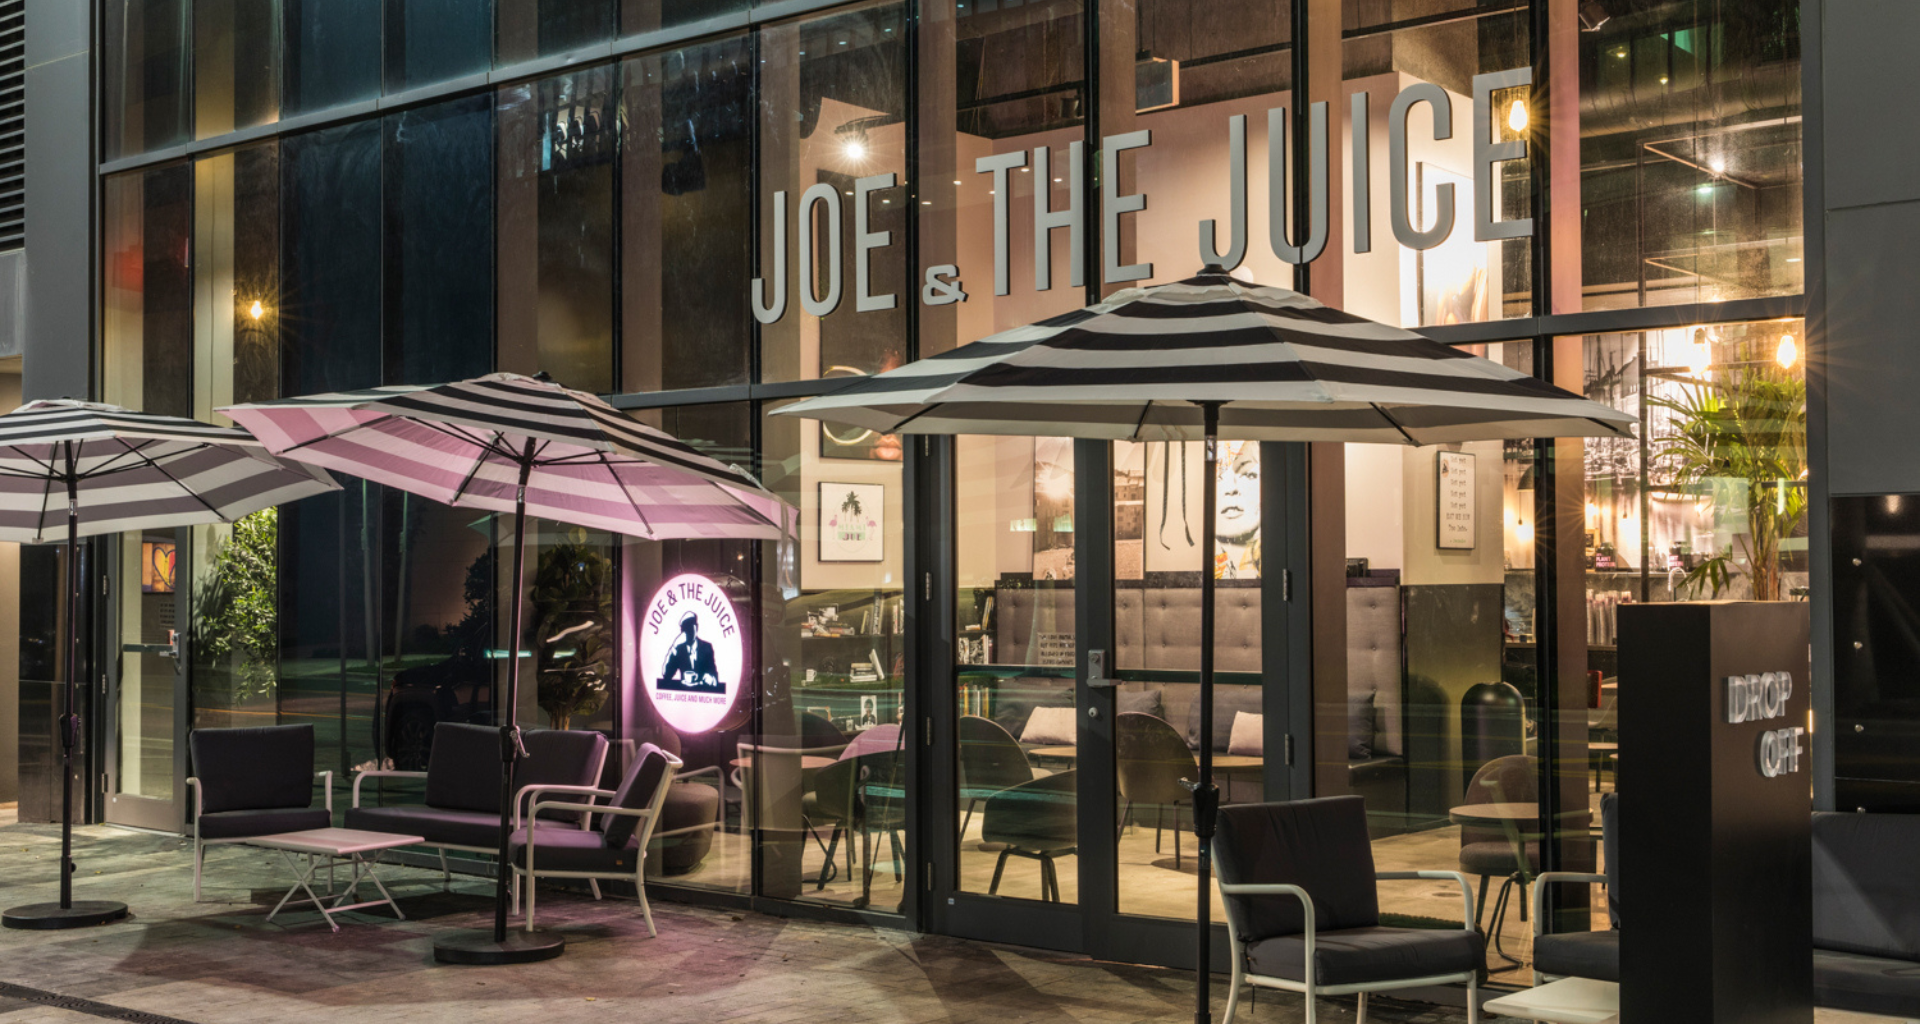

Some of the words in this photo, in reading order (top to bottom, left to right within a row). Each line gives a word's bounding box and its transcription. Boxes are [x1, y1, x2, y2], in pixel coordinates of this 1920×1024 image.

[751, 173, 898, 325] JOE
[921, 264, 968, 307] &
[975, 130, 1154, 297] THE
[1198, 66, 1534, 271] JUICE
[649, 599, 669, 635] JOE
[666, 589, 678, 607] &
[678, 582, 704, 601] THE
[704, 593, 735, 639] JUICE
[674, 693, 687, 702] JUICE
[688, 694, 698, 703] AND
[699, 695, 712, 704] MUCH
[713, 696, 727, 705] MORE
[1728, 671, 1792, 723] DROP
[1761, 727, 1804, 778] OFF
